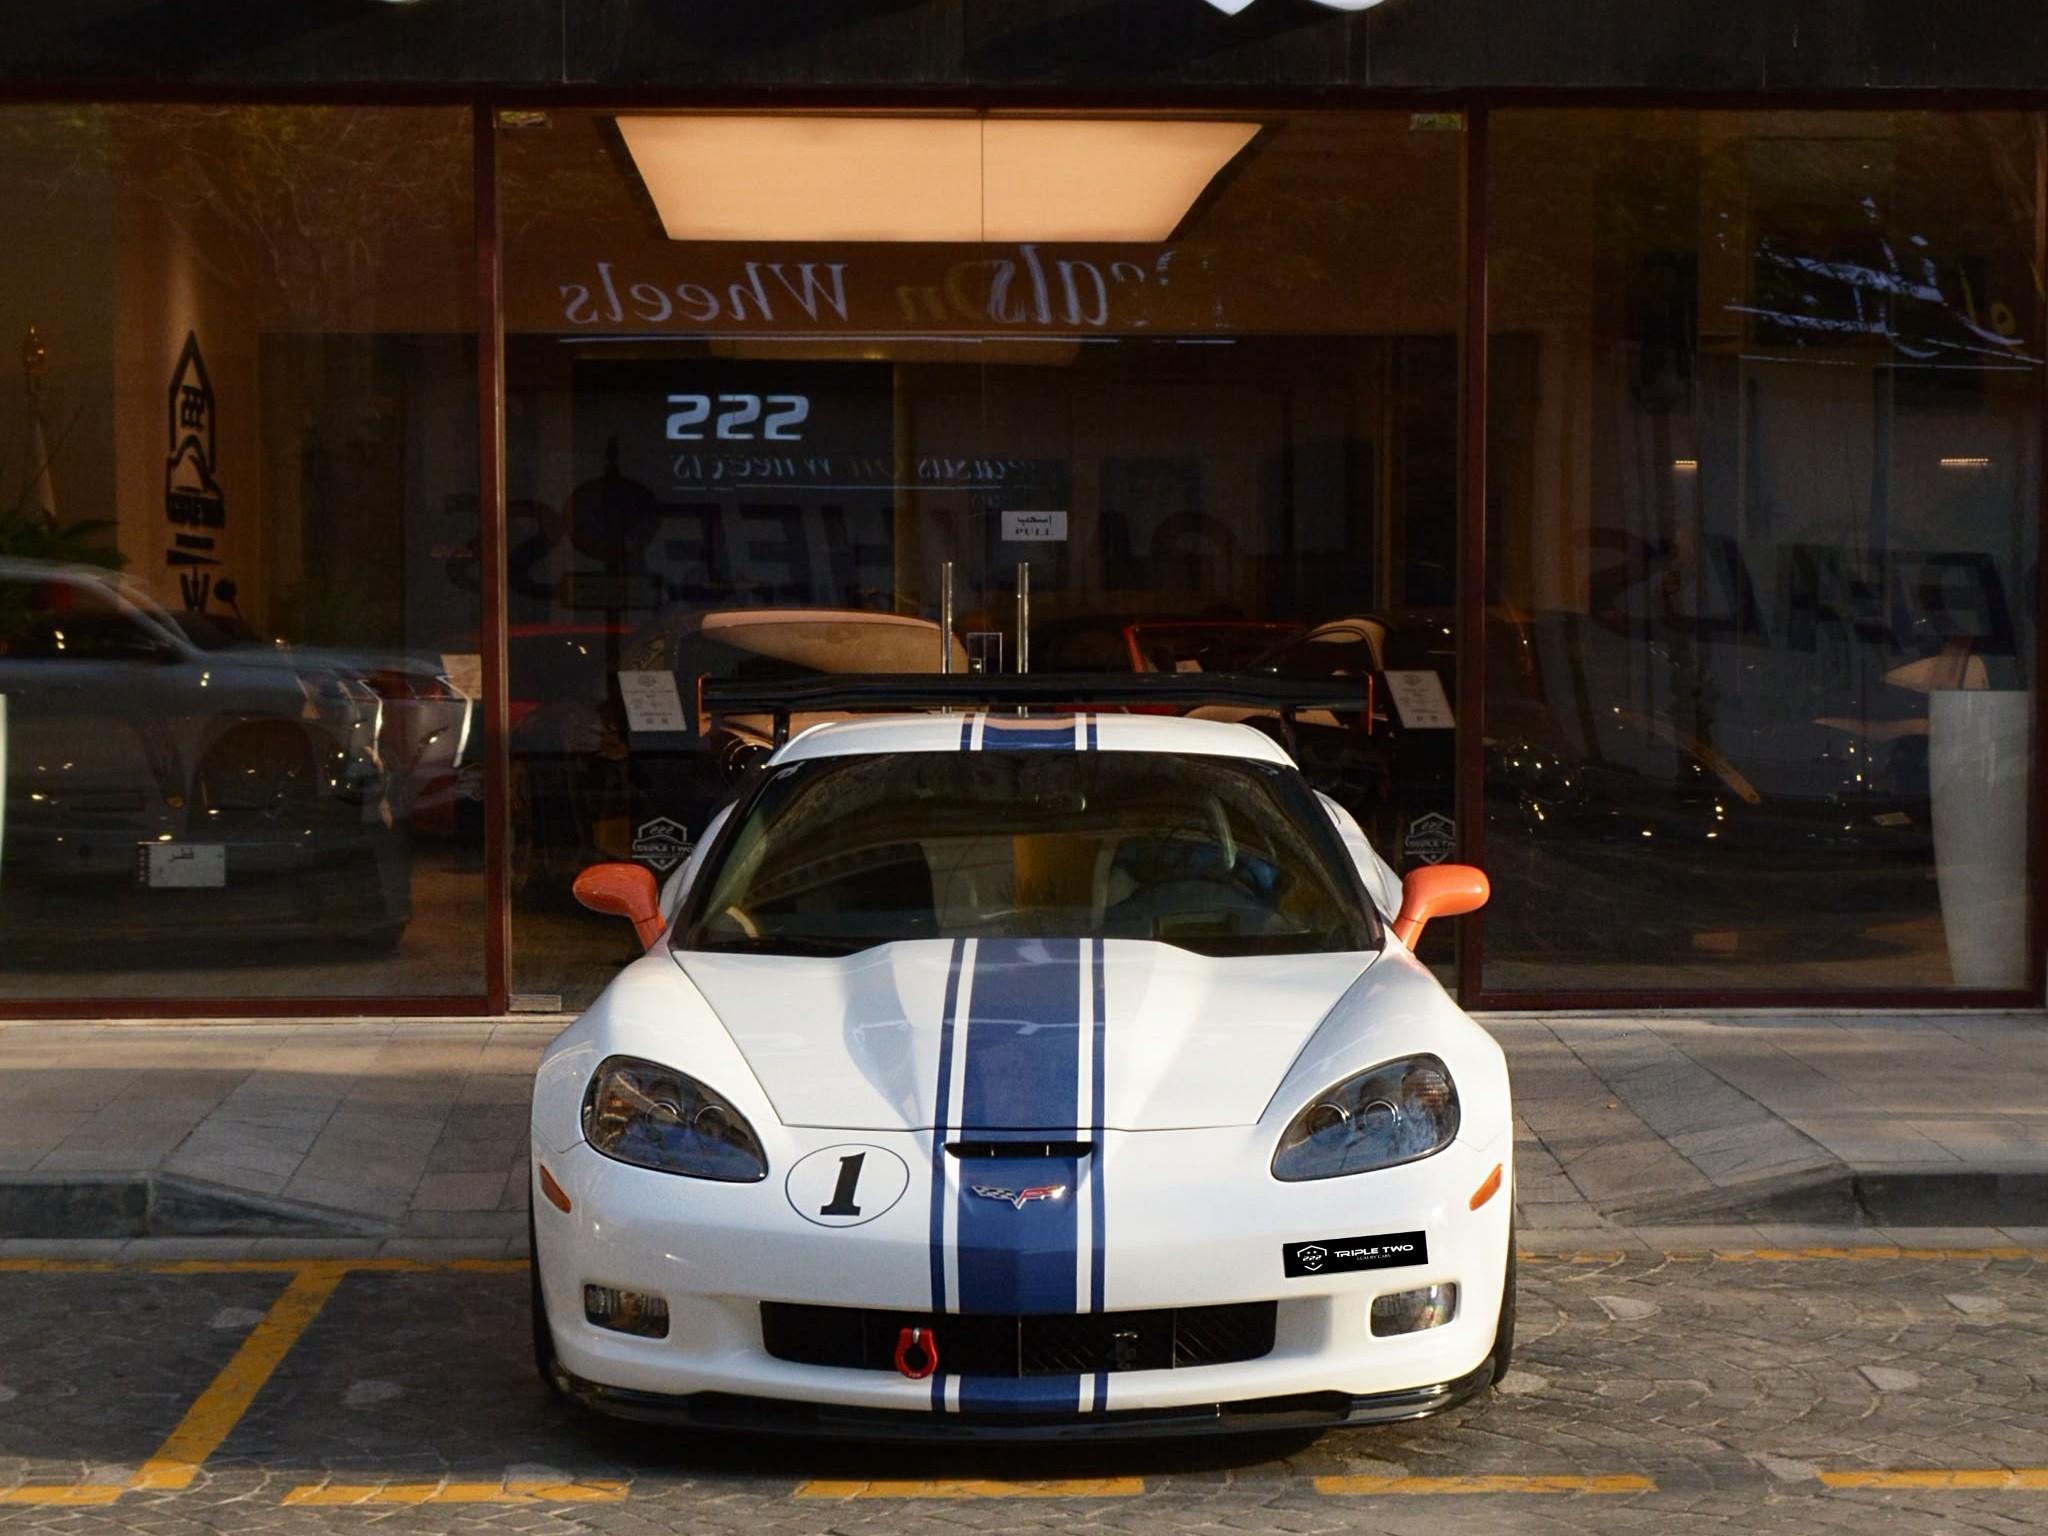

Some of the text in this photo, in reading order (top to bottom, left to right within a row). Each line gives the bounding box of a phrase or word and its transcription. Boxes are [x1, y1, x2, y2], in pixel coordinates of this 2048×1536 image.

[666, 394, 810, 441] 222
[1015, 527, 1055, 536] PULL
[820, 1151, 866, 1217] 1
[1302, 1254, 1323, 1262] 222
[1333, 1244, 1414, 1258] TRIPLE TWO
